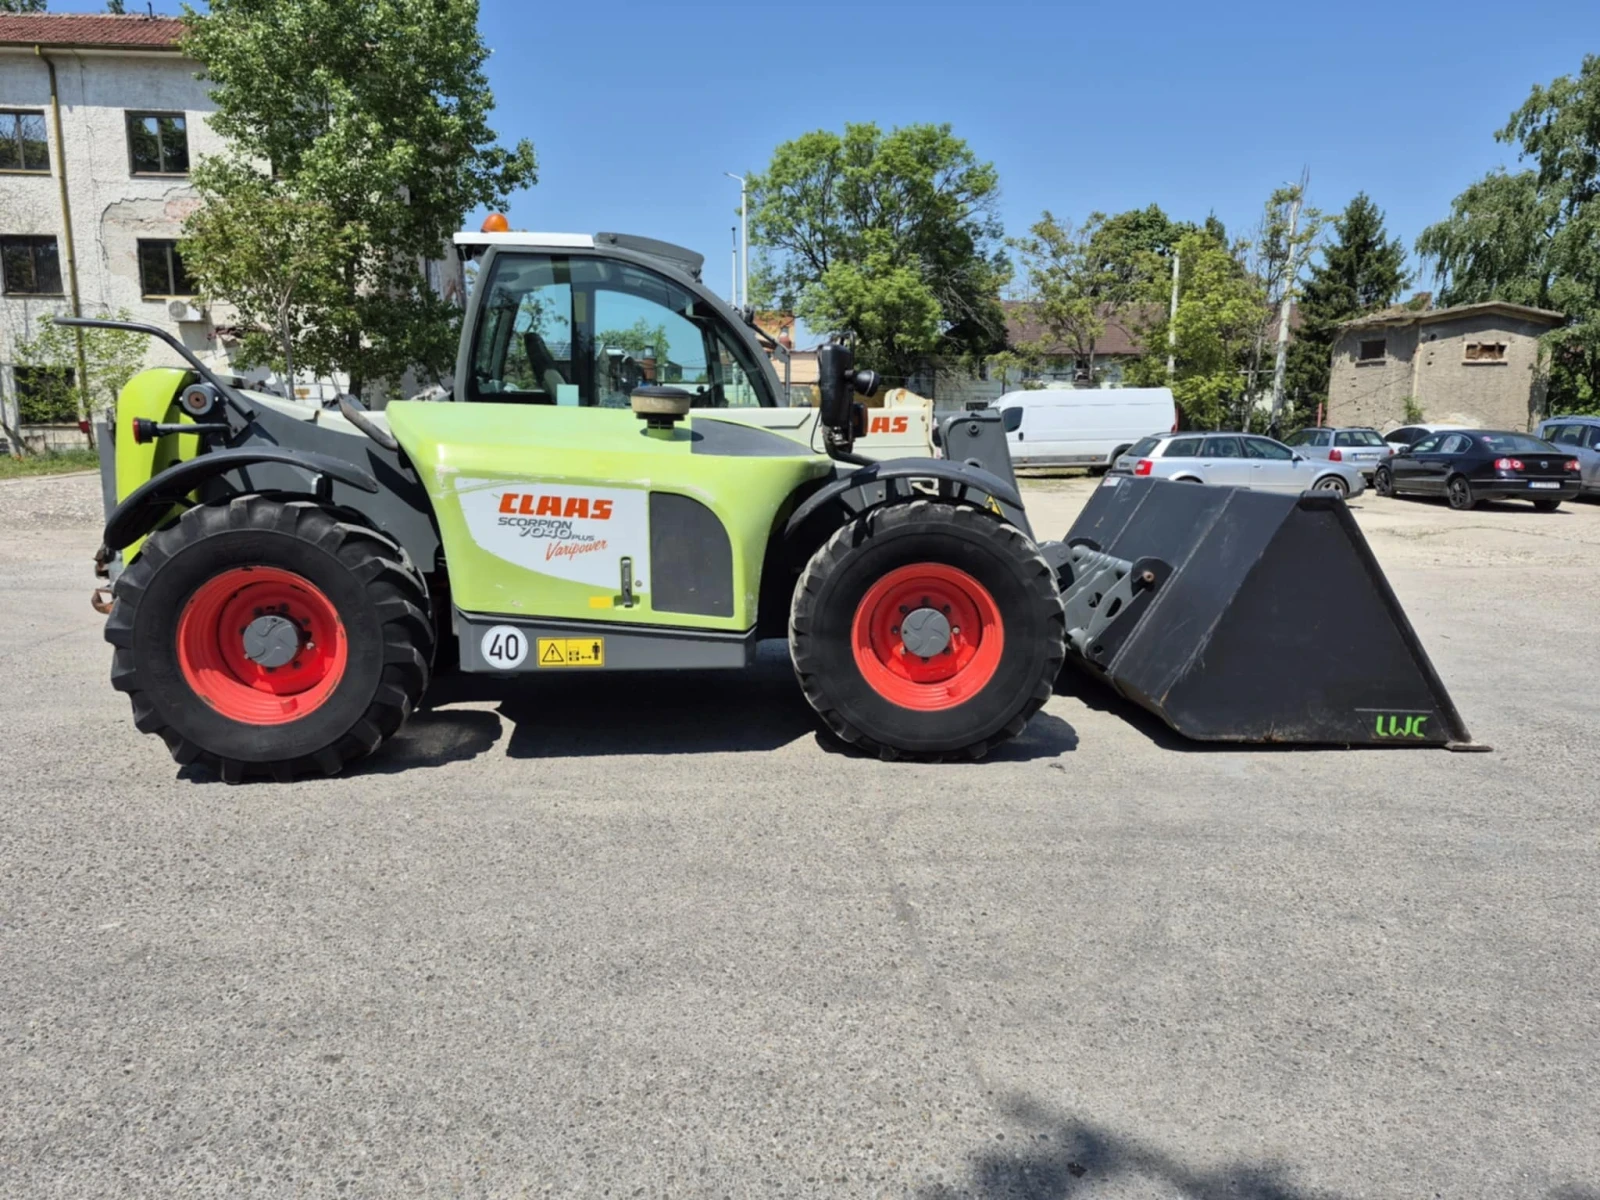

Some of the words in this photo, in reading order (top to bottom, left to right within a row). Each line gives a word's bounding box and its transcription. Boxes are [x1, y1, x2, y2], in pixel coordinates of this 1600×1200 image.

[870, 416, 909, 434] AS
[498, 493, 613, 519] CLAAS
[497, 516, 573, 530] SCORPION
[519, 525, 573, 540] 7040
[571, 533, 595, 542] PLUS
[545, 539, 608, 562] Varipower
[489, 633, 519, 661] 40
[1375, 715, 1429, 738] LWC
